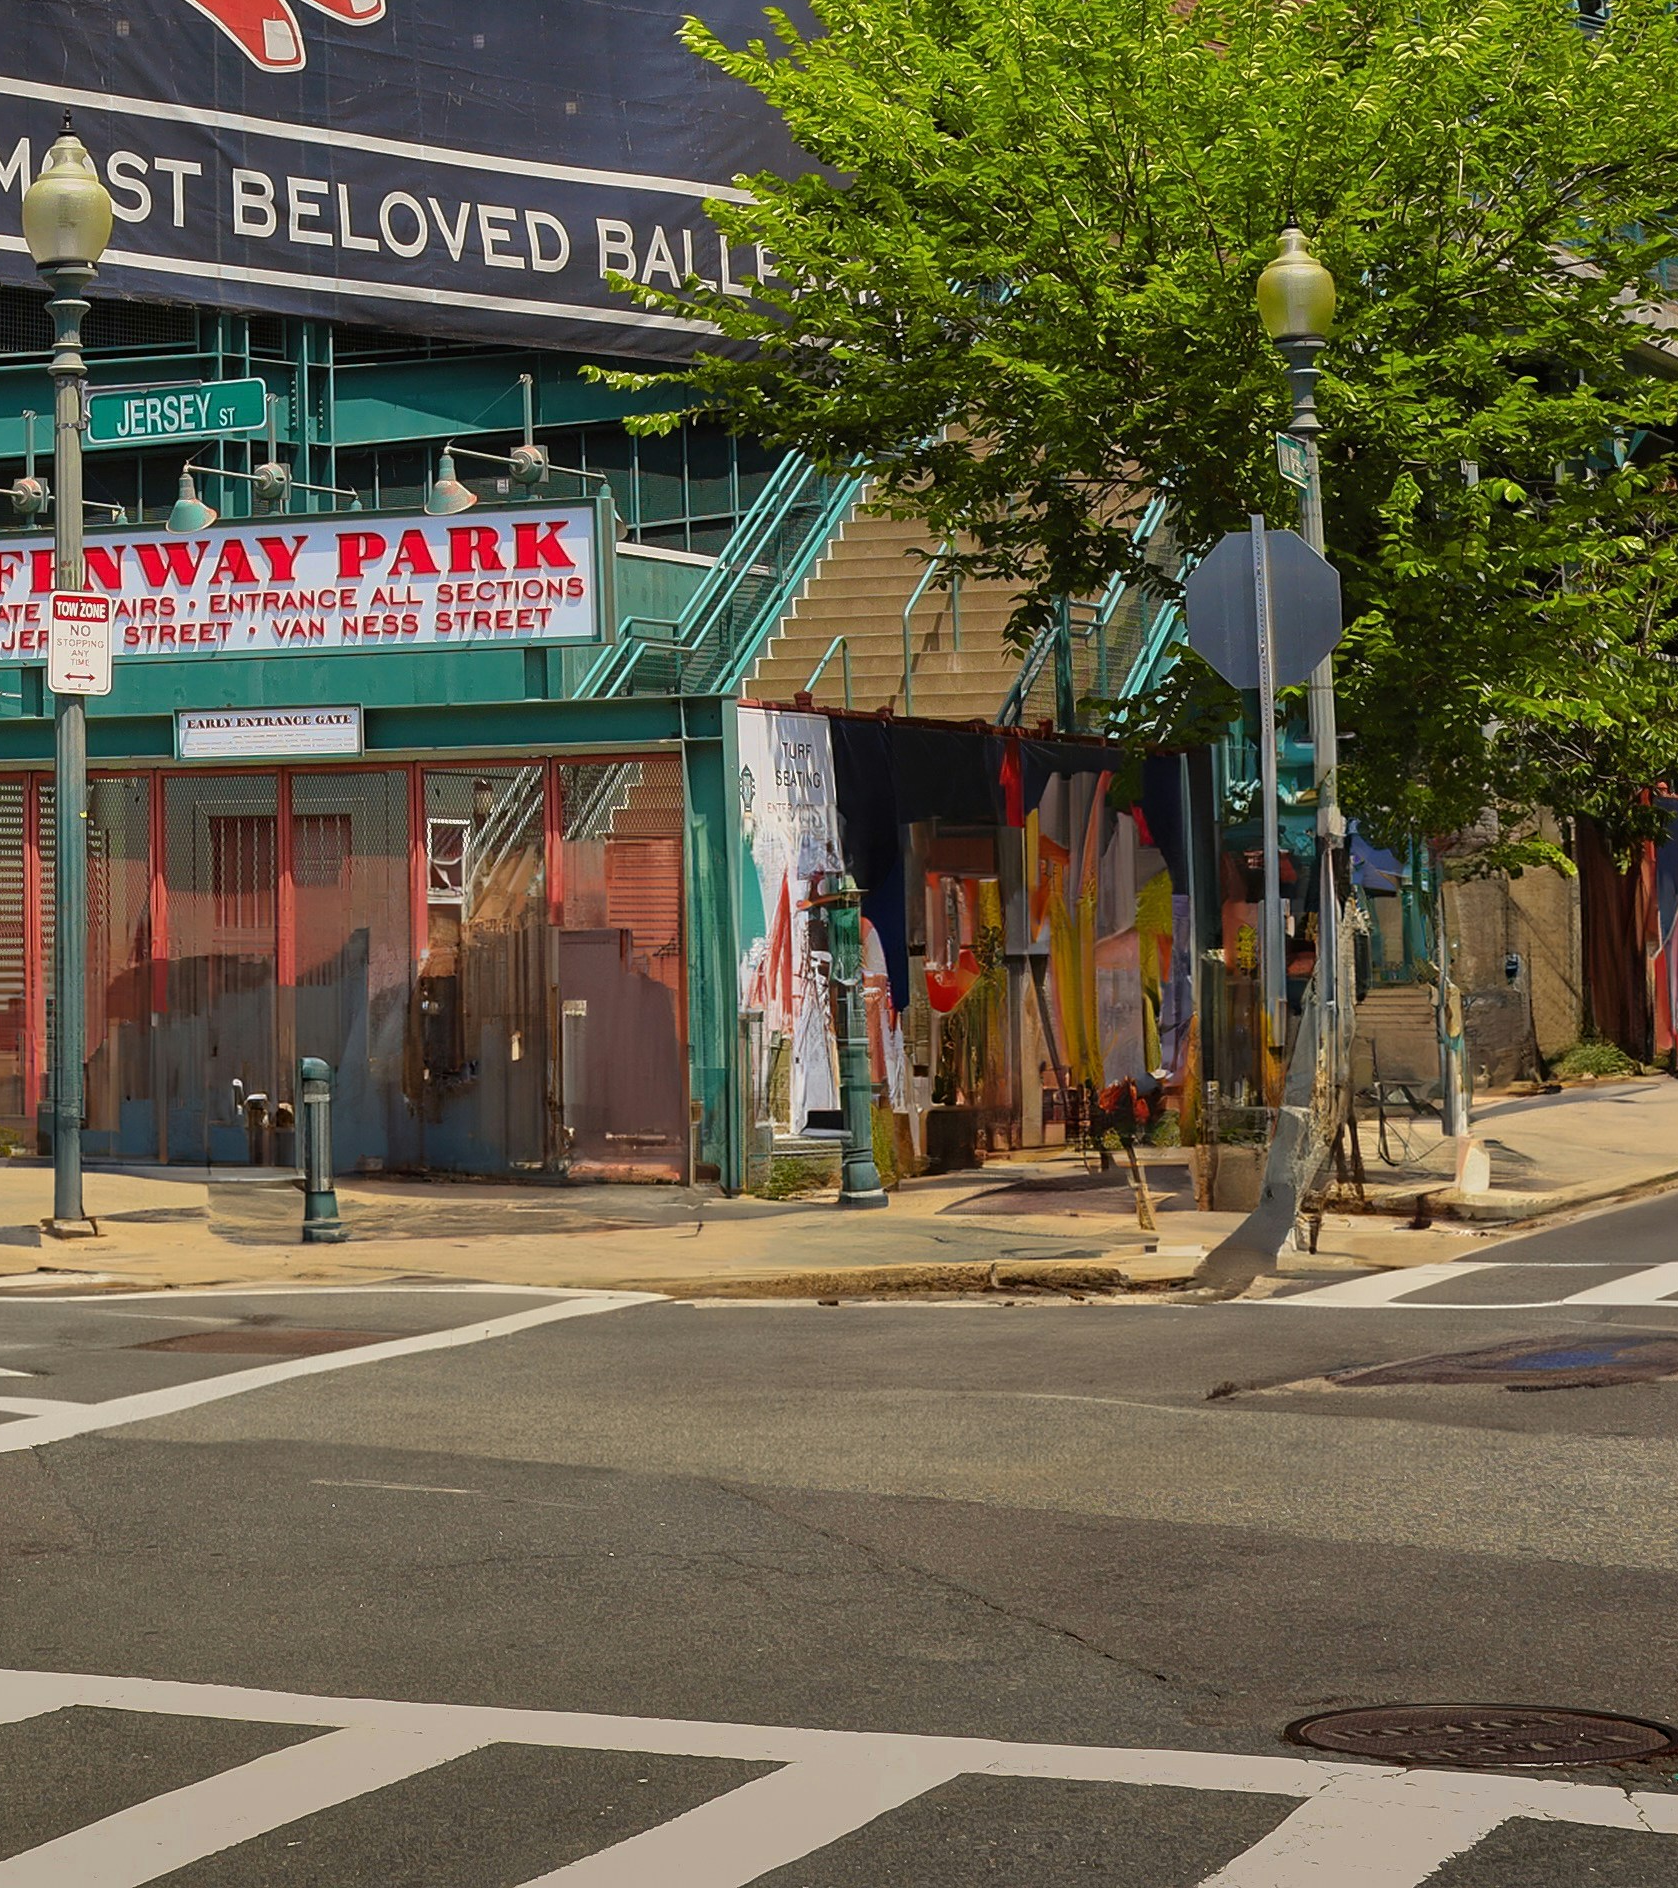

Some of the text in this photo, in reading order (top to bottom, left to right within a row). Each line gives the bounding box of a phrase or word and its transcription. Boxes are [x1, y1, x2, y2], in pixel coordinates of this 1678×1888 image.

[233, 168, 571, 274] BELOVED
[116, 392, 236, 437] JERSEY ST
[335, 520, 577, 579] PARK
[112, 597, 176, 619] AIRS
[209, 587, 358, 614] ENTRANCE
[370, 585, 423, 607] ALL
[436, 577, 584, 604] SECTIONS
[56, 601, 106, 619] TOW ZONE
[70, 624, 91, 637] NO
[124, 621, 232, 646] STREET
[272, 618, 325, 639] VAN
[343, 614, 419, 637] NESS
[435, 607, 552, 633] STREET
[57, 638, 104, 649] STOPPING
[71, 650, 90, 658] ANY
[71, 658, 90, 667] TIME
[187, 714, 353, 729] EARLY ENTRANCE GATE
[782, 741, 812, 760] TURF
[775, 770, 821, 789] SEATING
